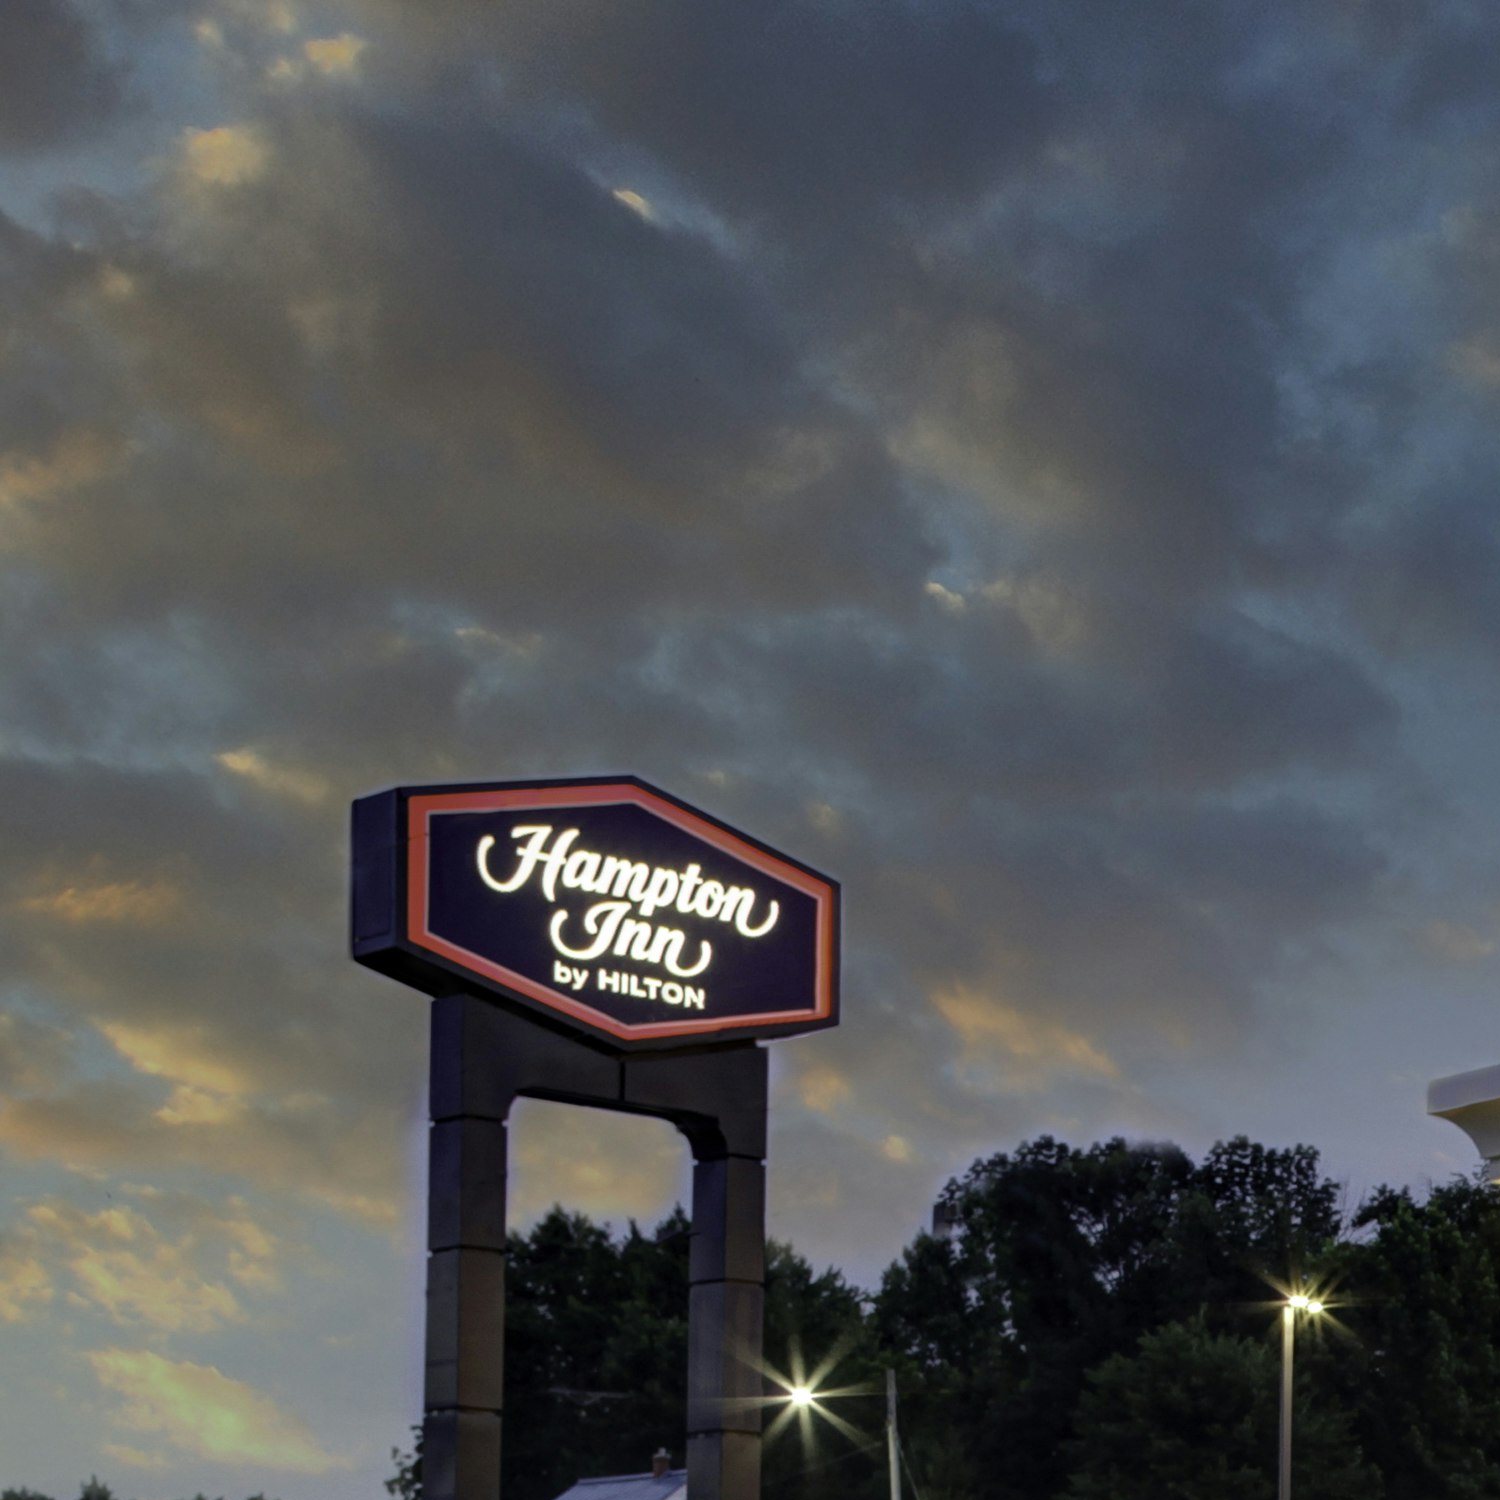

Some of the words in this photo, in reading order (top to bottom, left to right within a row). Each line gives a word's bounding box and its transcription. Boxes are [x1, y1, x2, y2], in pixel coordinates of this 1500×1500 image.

[477, 825, 779, 938] Hampton
[550, 901, 712, 978] Inn
[553, 960, 589, 991] by
[597, 967, 706, 1010] HILTON
